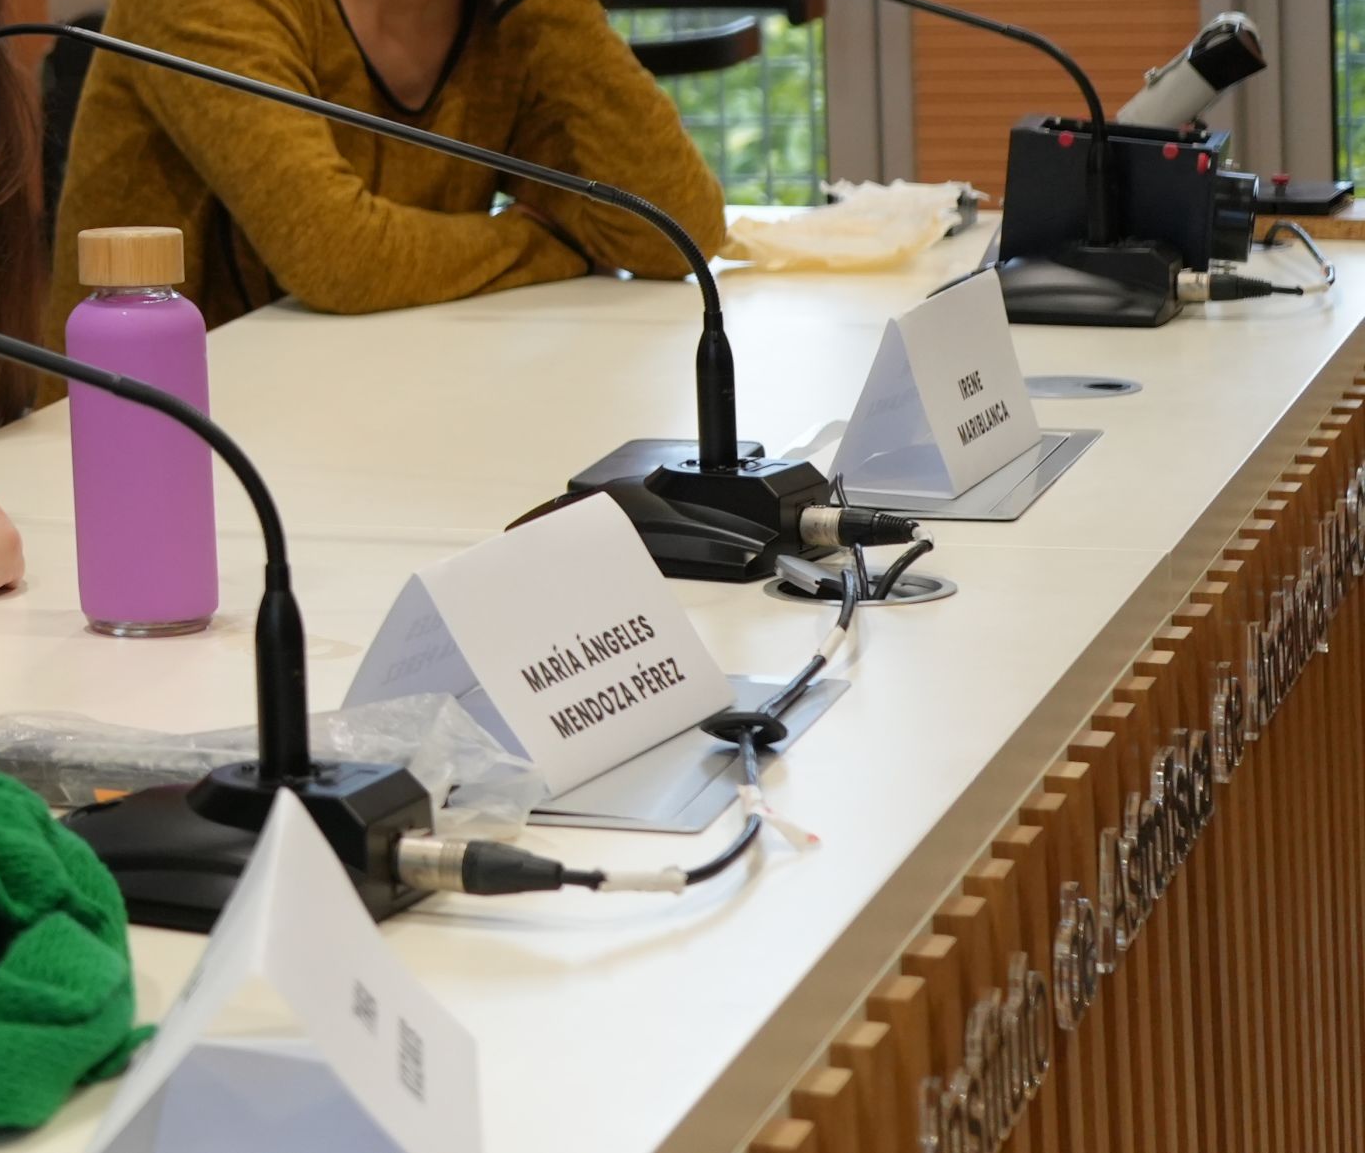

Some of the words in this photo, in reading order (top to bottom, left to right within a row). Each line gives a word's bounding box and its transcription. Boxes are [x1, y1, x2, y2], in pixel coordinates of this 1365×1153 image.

[958, 370, 983, 400] IRENE
[957, 399, 1011, 446] MARIBLANCA
[521, 644, 586, 693] MARÍA
[576, 614, 655, 667] ÁNGELES
[549, 681, 639, 739] MENDOZA
[630, 657, 686, 699] PÉREZ
